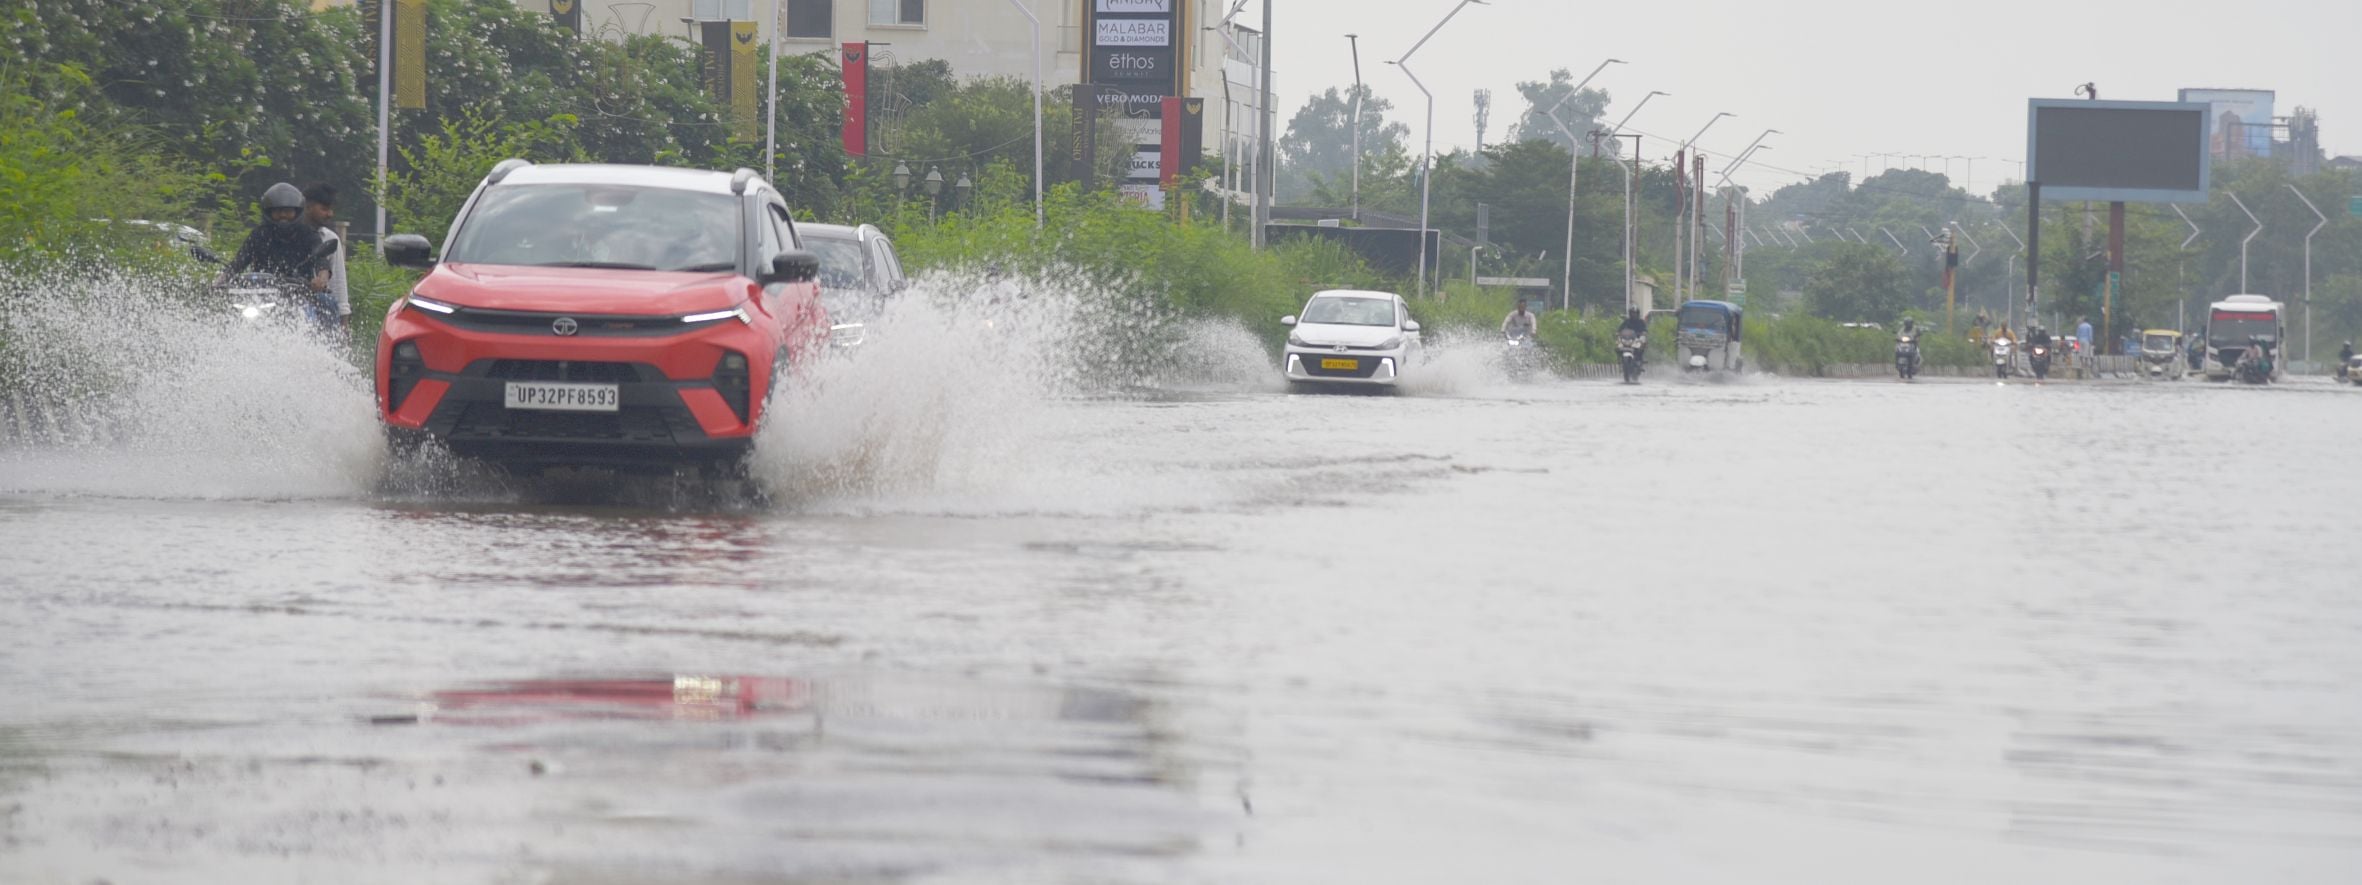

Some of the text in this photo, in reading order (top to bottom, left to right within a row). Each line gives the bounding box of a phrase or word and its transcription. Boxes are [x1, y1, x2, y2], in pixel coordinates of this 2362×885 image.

[1099, 23, 1165, 34] MALABAR
[1099, 35, 1119, 43] GOLD
[1127, 35, 1165, 43] DIAMONDS
[1097, 94, 1127, 103] VERO
[517, 387, 616, 405] UP32PF8593
